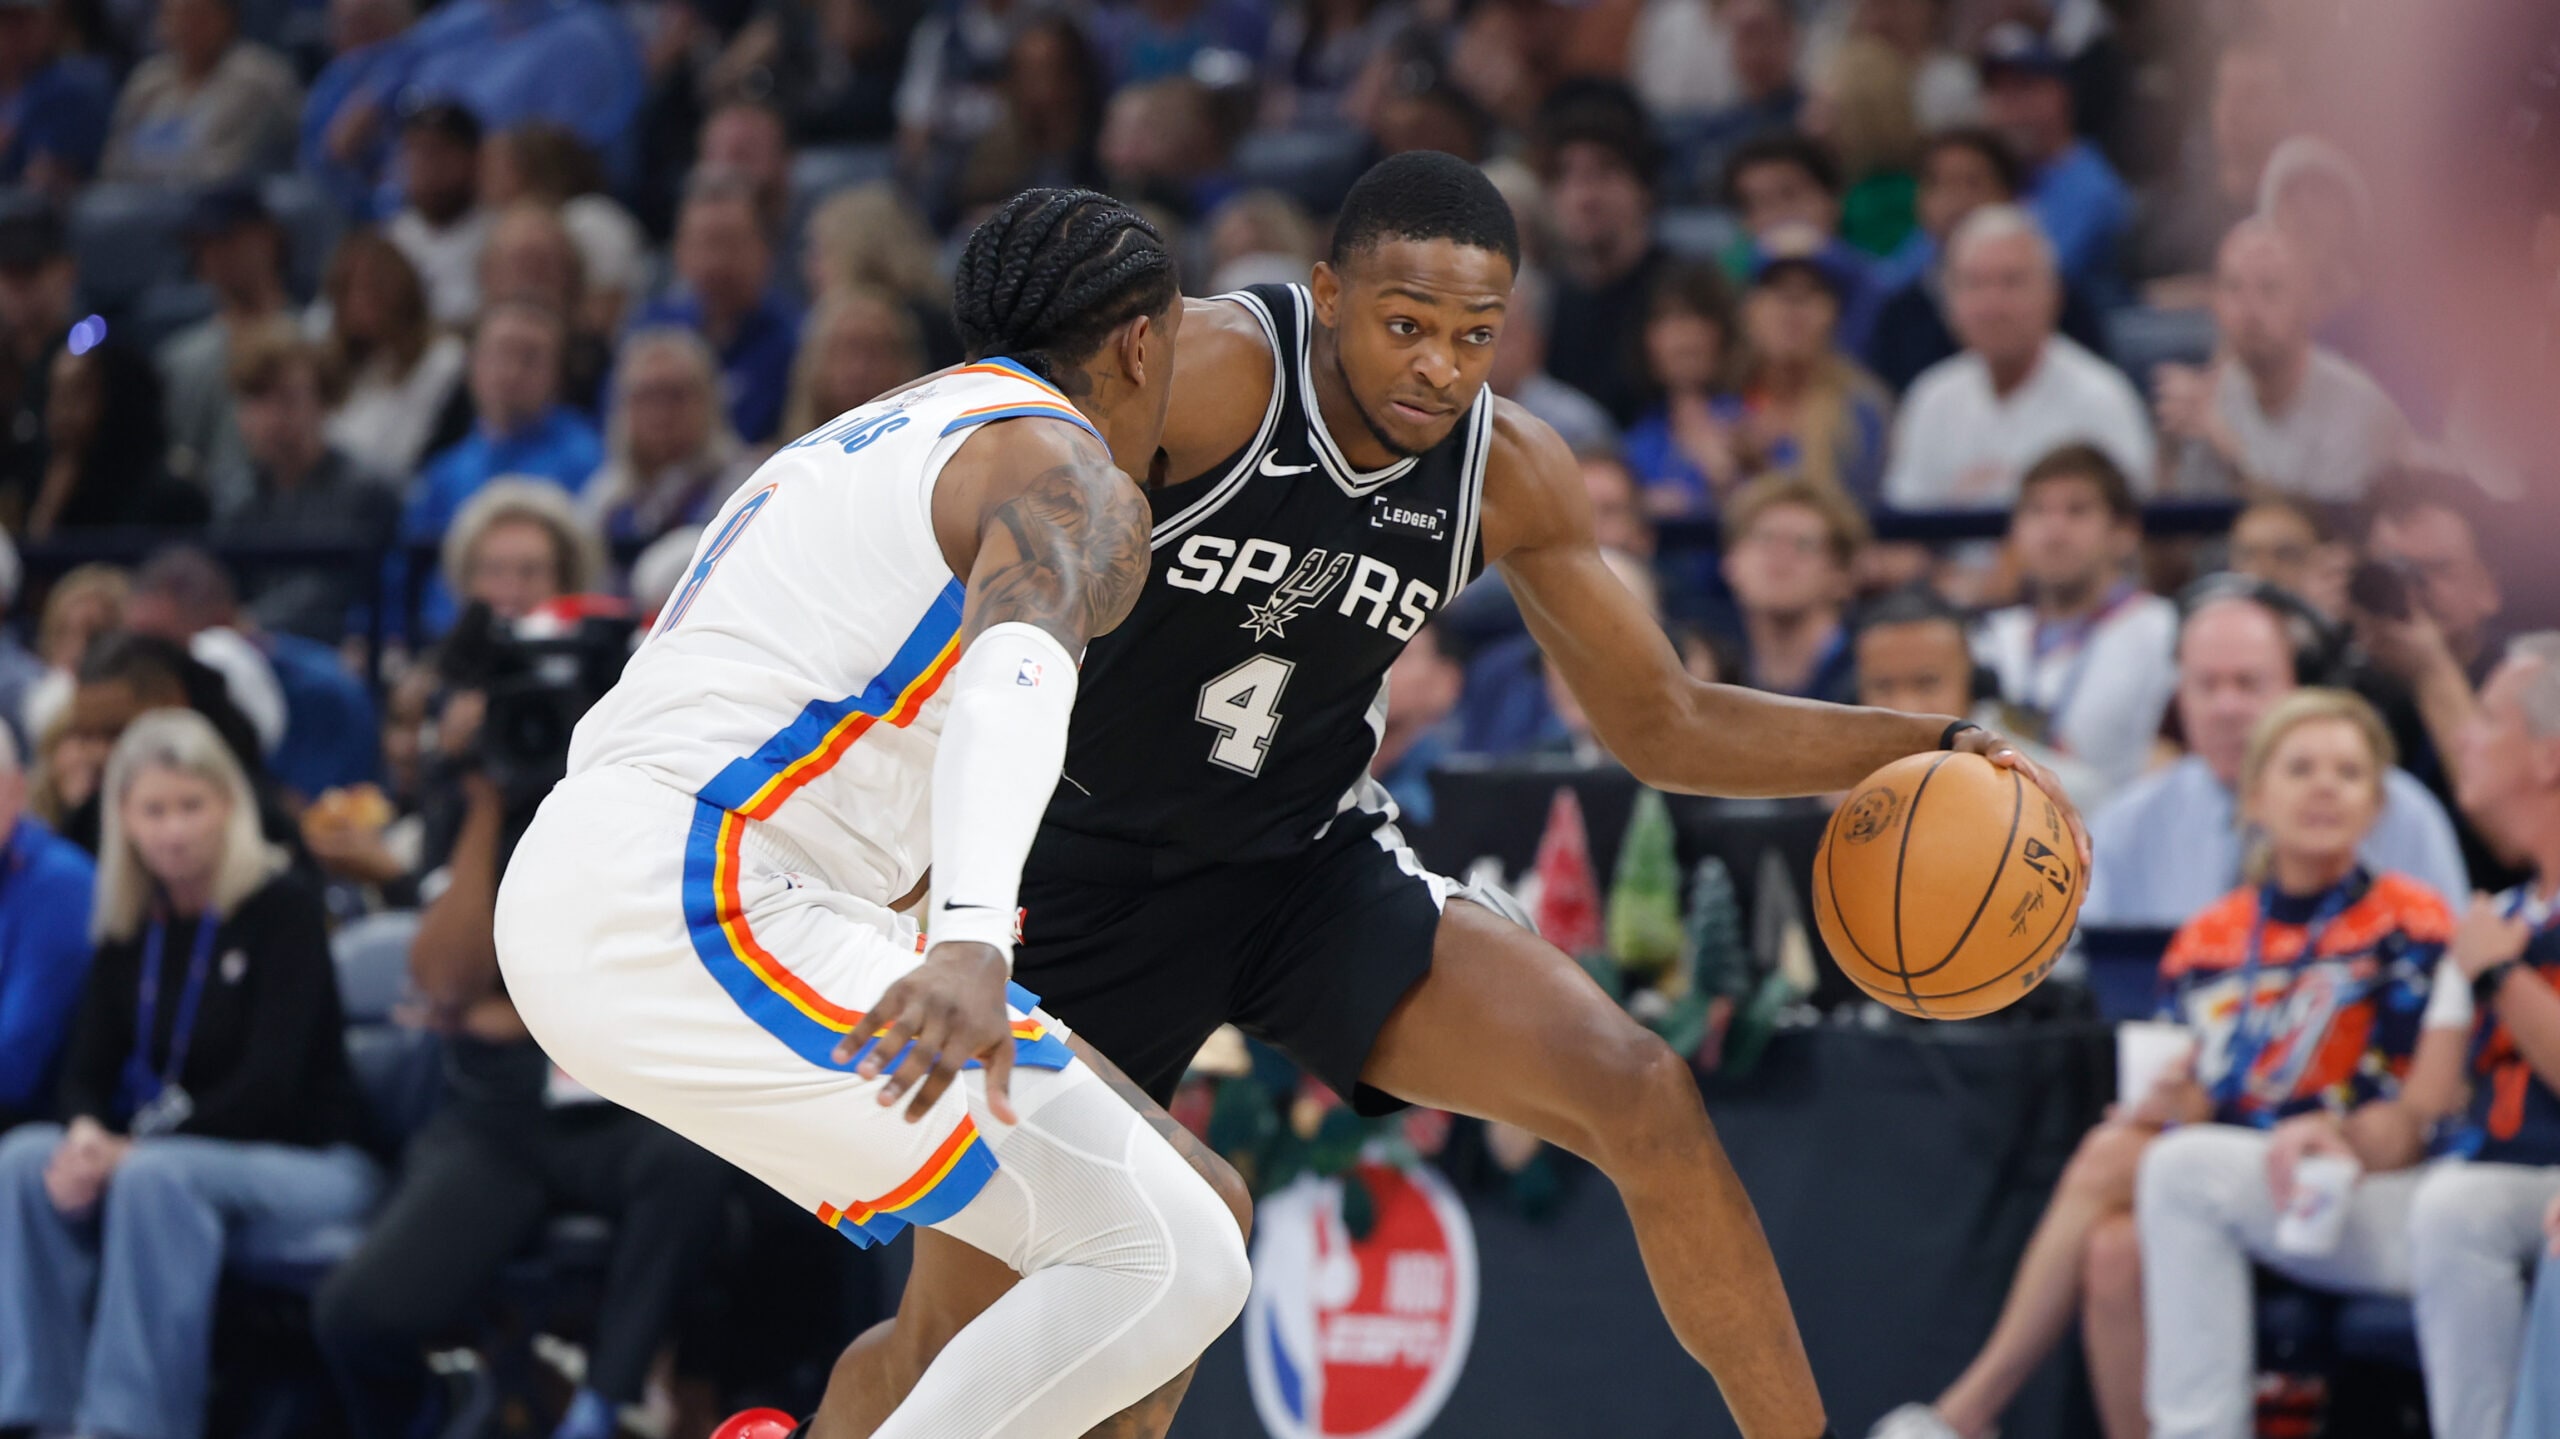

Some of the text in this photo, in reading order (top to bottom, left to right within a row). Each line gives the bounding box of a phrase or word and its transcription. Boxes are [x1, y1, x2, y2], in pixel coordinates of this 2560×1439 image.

[1382, 505, 1438, 531] LEDGER
[1165, 534, 1440, 643] SPURS
[1194, 652, 1297, 780] 4
